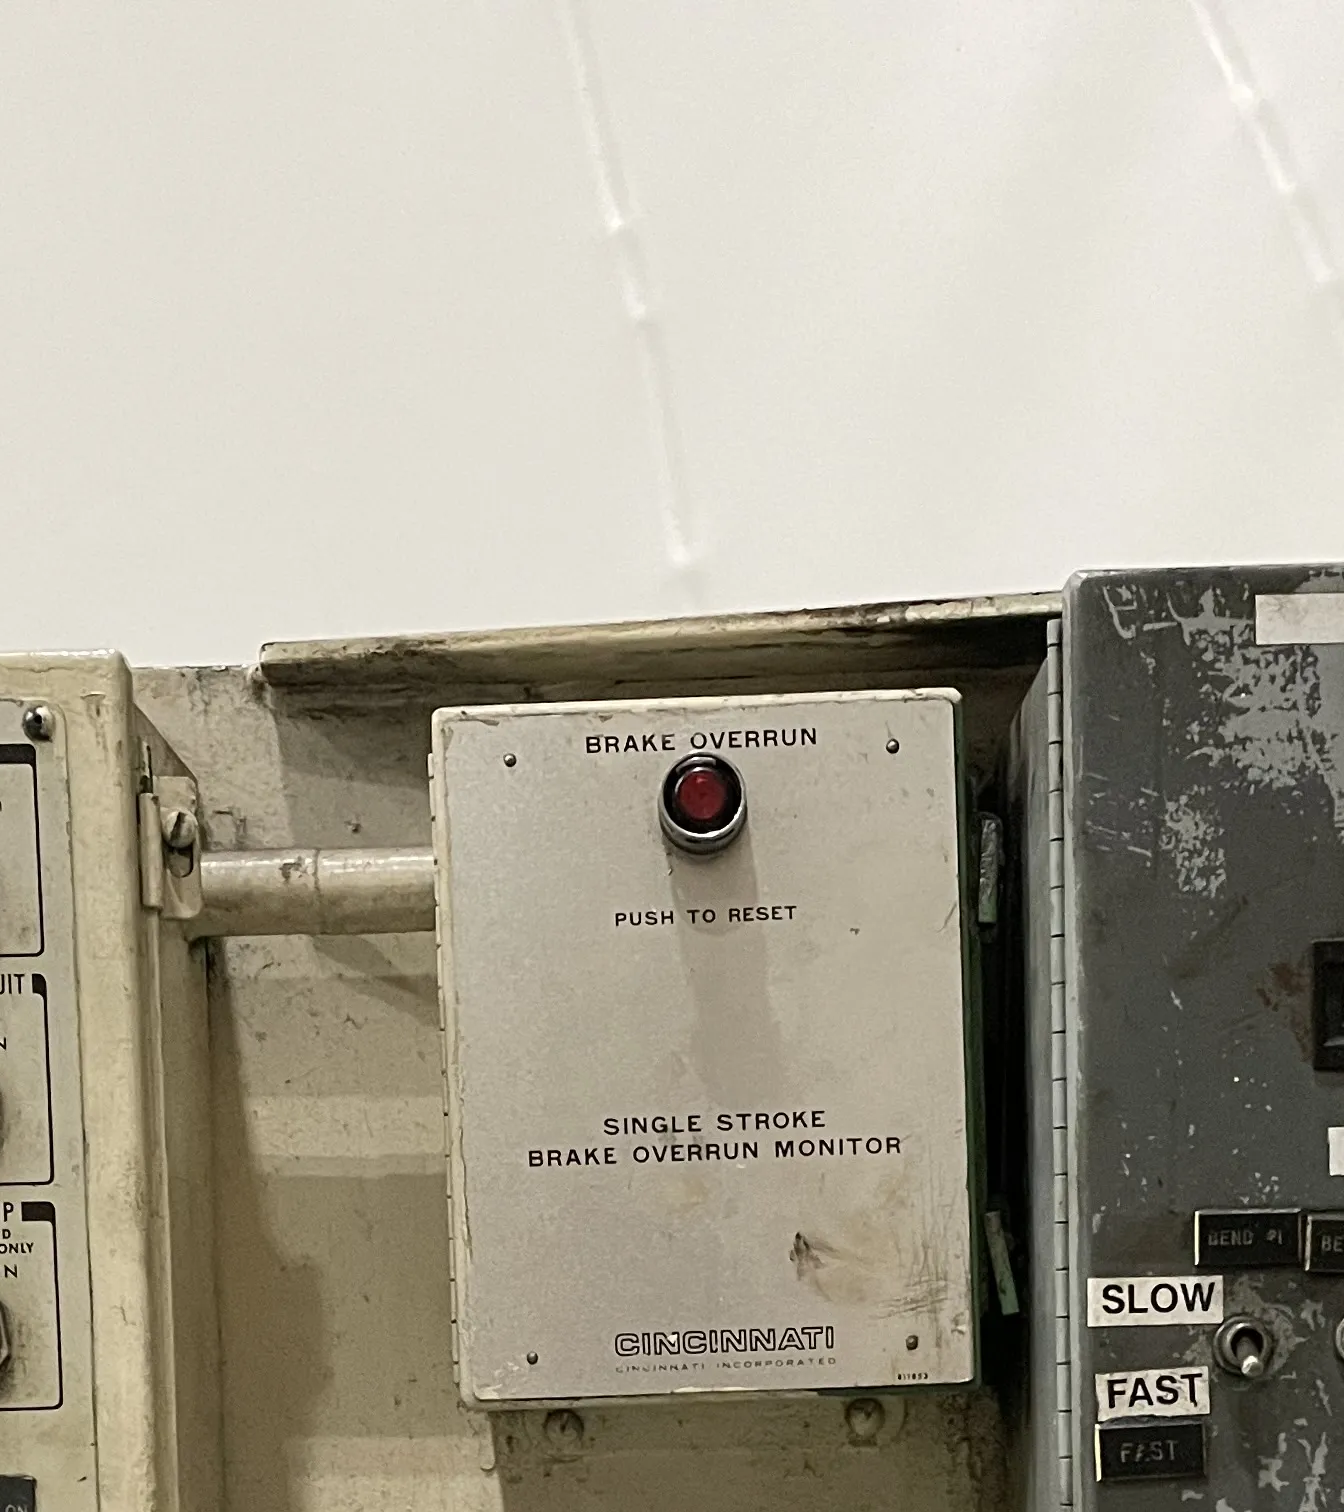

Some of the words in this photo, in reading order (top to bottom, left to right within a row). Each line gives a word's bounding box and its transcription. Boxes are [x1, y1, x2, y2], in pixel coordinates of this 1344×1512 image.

[585, 733, 676, 755] BRAKE
[689, 728, 818, 750] OVERRUN
[614, 910, 675, 927] PUSH
[686, 908, 717, 925] TO
[728, 905, 798, 924] RESET
[603, 1114, 702, 1136] SINGLE
[716, 1110, 826, 1132] STROKE
[527, 1145, 617, 1168] BRAKE
[632, 1141, 758, 1164] OVERRUN
[774, 1136, 902, 1159] MONITOR
[1101, 1282, 1216, 1314] SLOW
[615, 1325, 835, 1357] CINCINNATI
[1106, 1373, 1203, 1409] FAST
[1119, 1440, 1180, 1464] FAST
